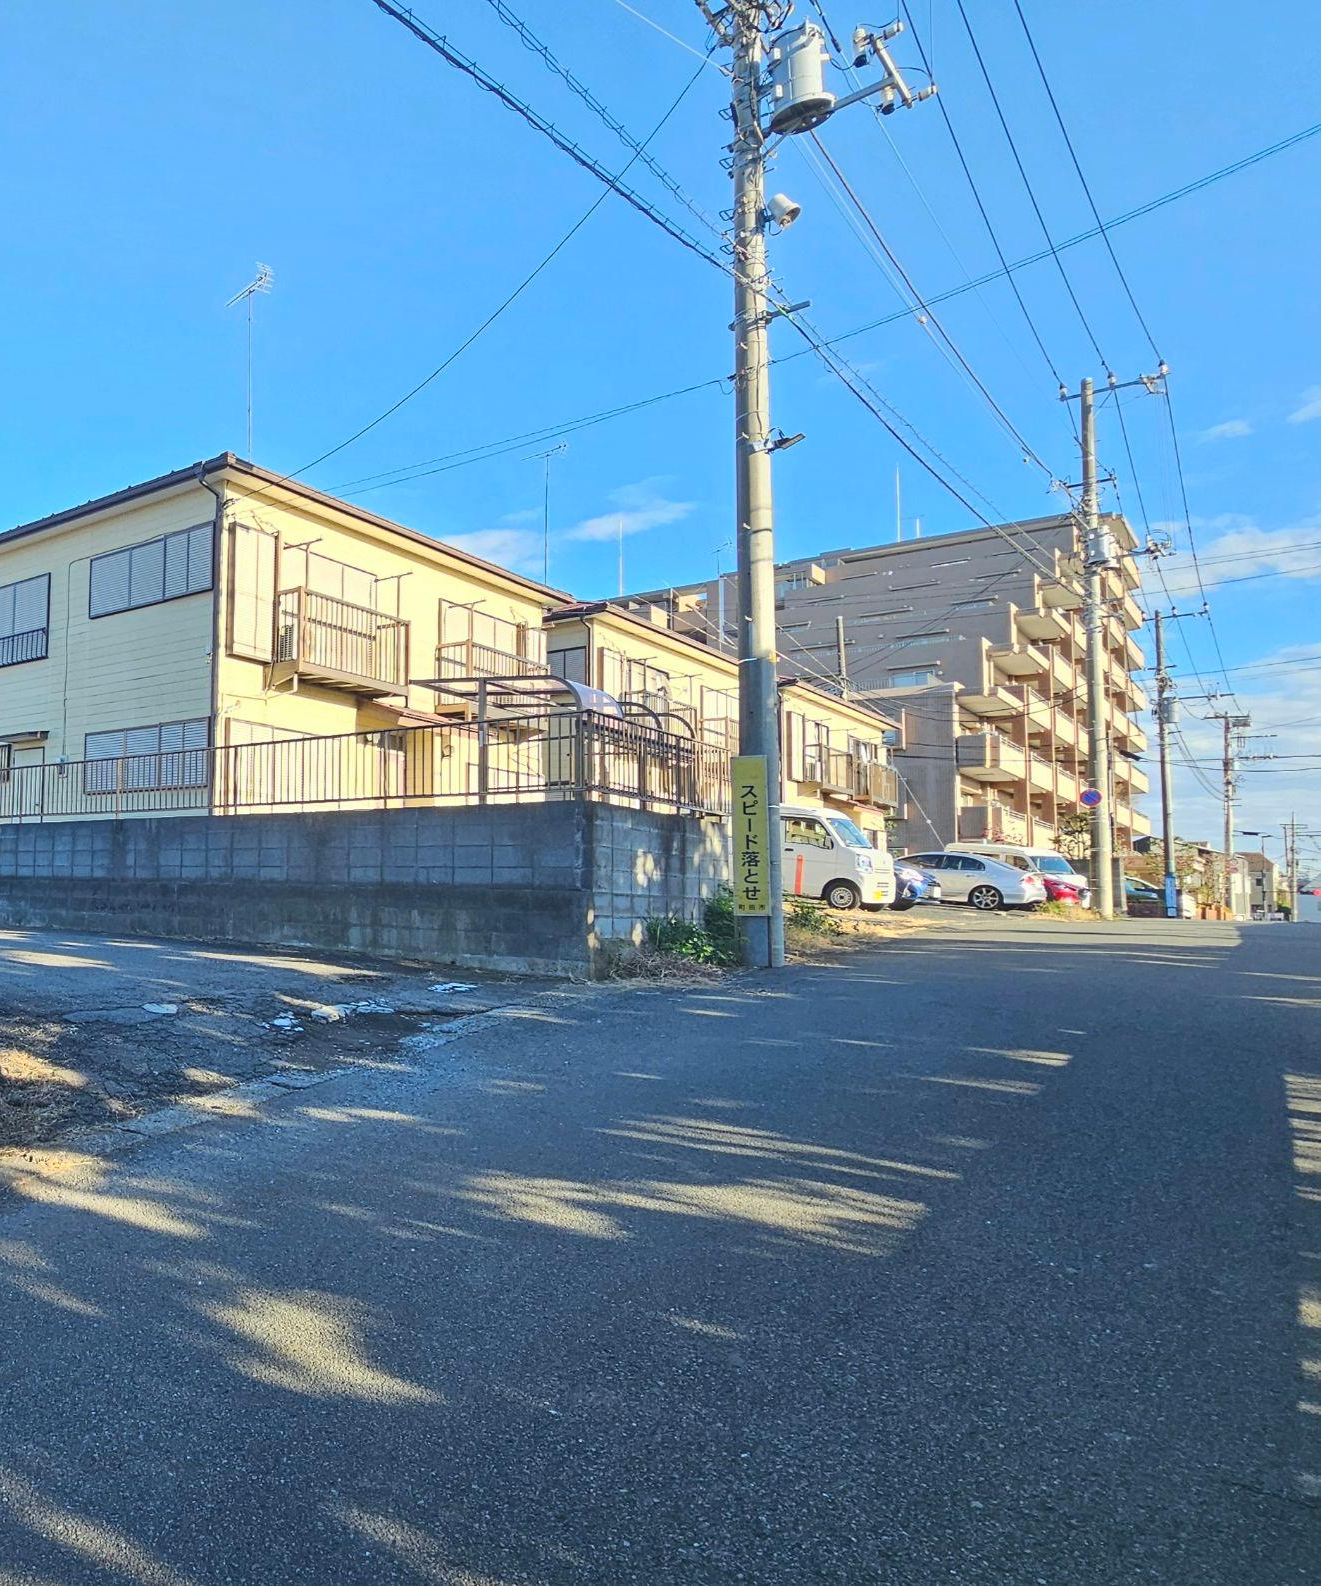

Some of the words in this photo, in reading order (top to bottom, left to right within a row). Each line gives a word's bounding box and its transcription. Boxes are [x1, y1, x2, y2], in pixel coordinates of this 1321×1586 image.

[741, 785, 761, 900] スピード落とせ
